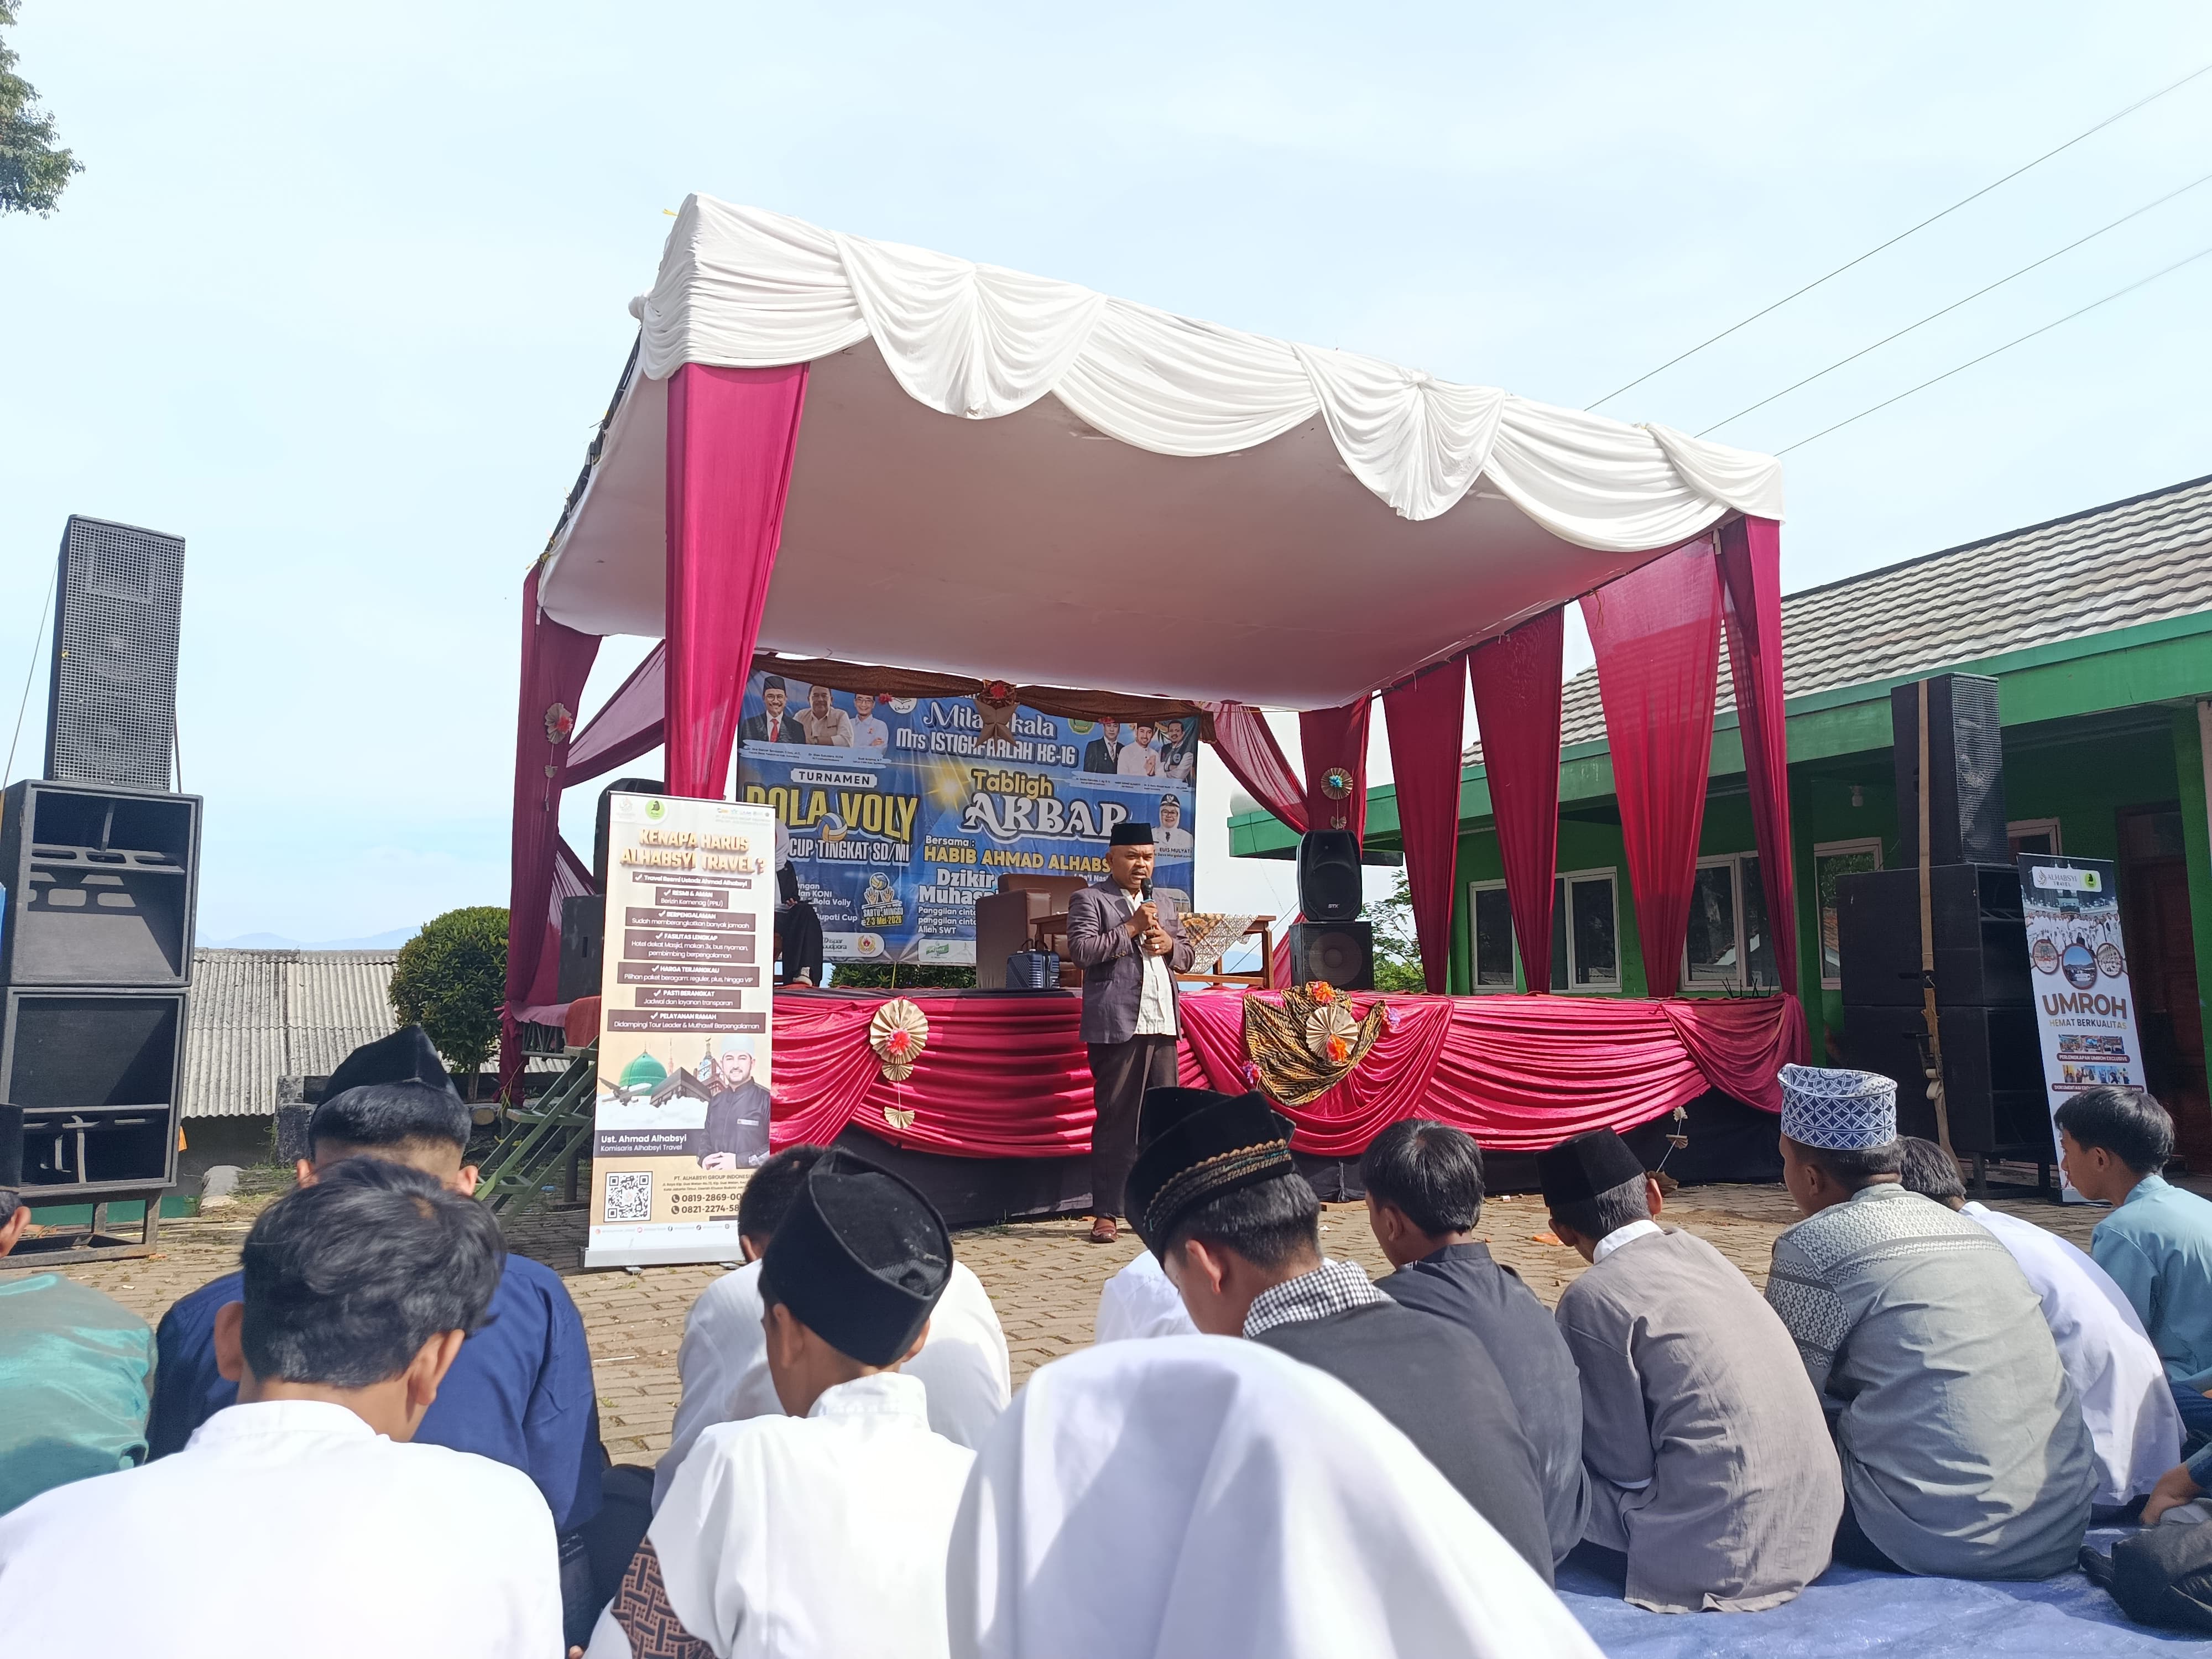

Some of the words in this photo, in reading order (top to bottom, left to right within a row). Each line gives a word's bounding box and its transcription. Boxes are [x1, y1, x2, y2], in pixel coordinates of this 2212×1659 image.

[923, 701, 1056, 737] Milakala
[799, 771, 870, 785] TURNAMEN
[973, 771, 1053, 800] Tabligh
[840, 792, 918, 842] VOLY
[639, 829, 698, 849] KENAPA
[700, 833, 750, 852] HARUS
[925, 835, 970, 847] Bersama
[789, 838, 814, 857] CUP
[818, 840, 869, 860] TINGKAT
[873, 842, 910, 862] SD/MI
[619, 849, 697, 869] ALHABSYI
[701, 854, 755, 873] TRAVEL
[924, 846, 977, 864] HABIB
[982, 850, 1044, 868] AHMAD
[1048, 854, 1112, 873] ALHABS
[936, 868, 995, 888] Dzikir
[832, 899, 851, 907] Volly
[919, 885, 999, 905] Muhas
[842, 914, 858, 922] Cup
[918, 906, 957, 916] Panggilan
[918, 917, 957, 926] panggilan
[2042, 992, 2127, 1019] UMROH
[2049, 1019, 2075, 1027] HEMAT
[2077, 1019, 2127, 1030] BERKUALITAS
[651, 1134, 687, 1144] Alhabsyi
[681, 1193, 742, 1202] 0819-2869-00
[681, 1204, 740, 1213] 0821-2274-58
